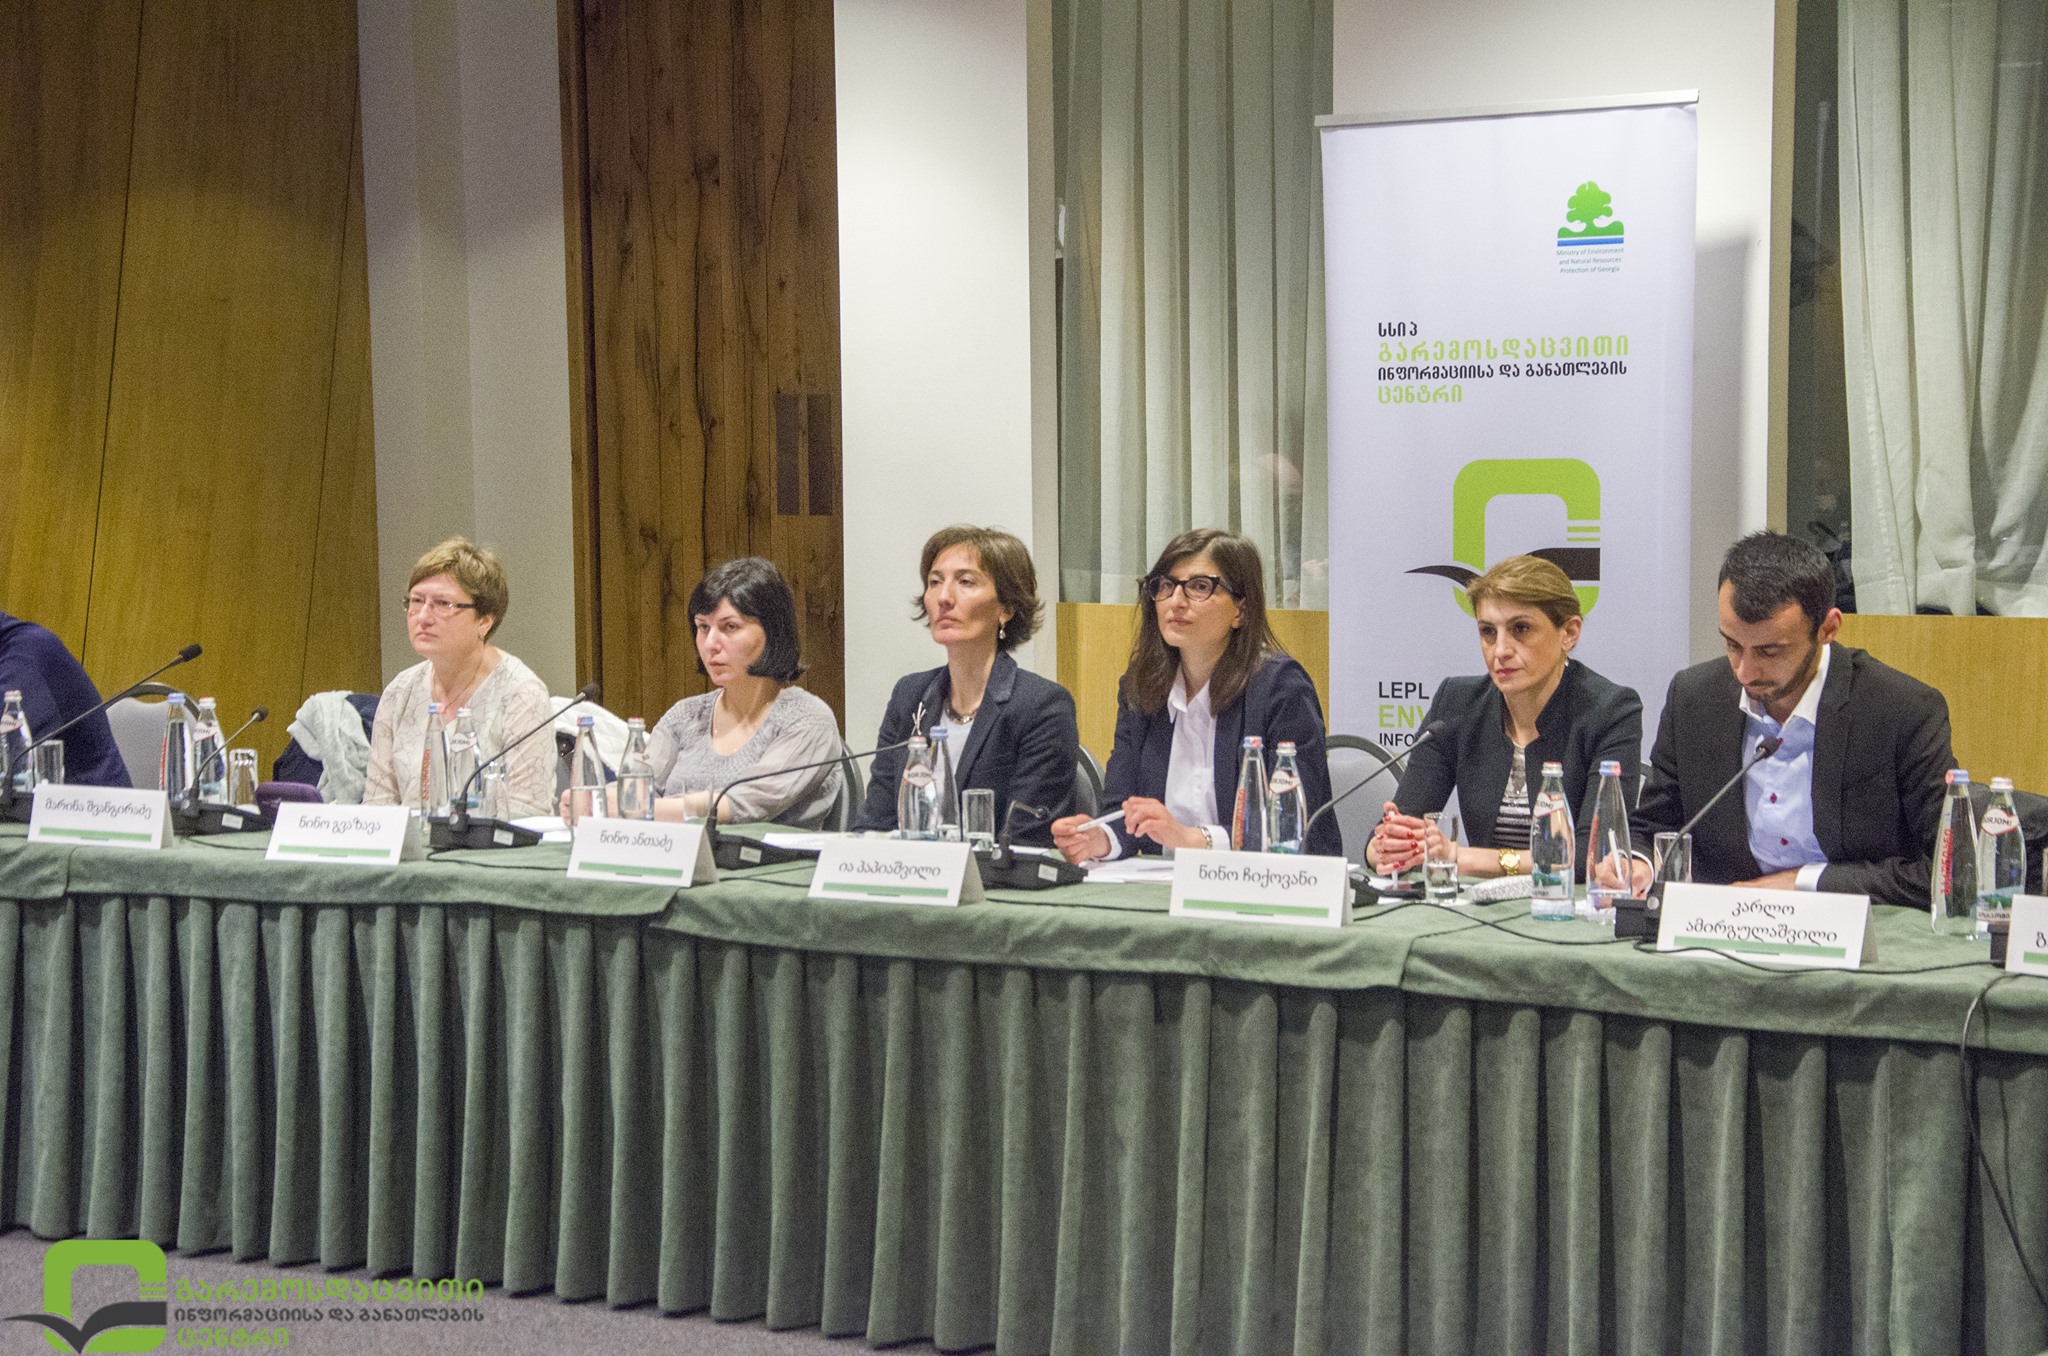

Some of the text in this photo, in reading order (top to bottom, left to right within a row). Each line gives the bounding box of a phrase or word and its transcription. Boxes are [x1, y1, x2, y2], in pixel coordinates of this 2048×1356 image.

[1597, 265, 1620, 273] Georgia
[1378, 335, 1629, 363] გარემოსდაცვითი
[1378, 360, 1627, 381] ინფორმაციისა და განათლების
[1378, 383, 1463, 404] ცენტრი
[1379, 681, 1430, 700] LEPL
[45, 797, 153, 820] მარინა შვანგირაძე
[299, 815, 381, 835] ნინო გვაზავა
[600, 830, 673, 852] ნინო ანთაძე
[839, 859, 941, 880] ია პაპიაშვილი
[1199, 864, 1318, 889] ნინო ჩიქოვანი
[1731, 899, 1795, 919] კარლო
[1686, 918, 1838, 947] ამირგულაშვილი
